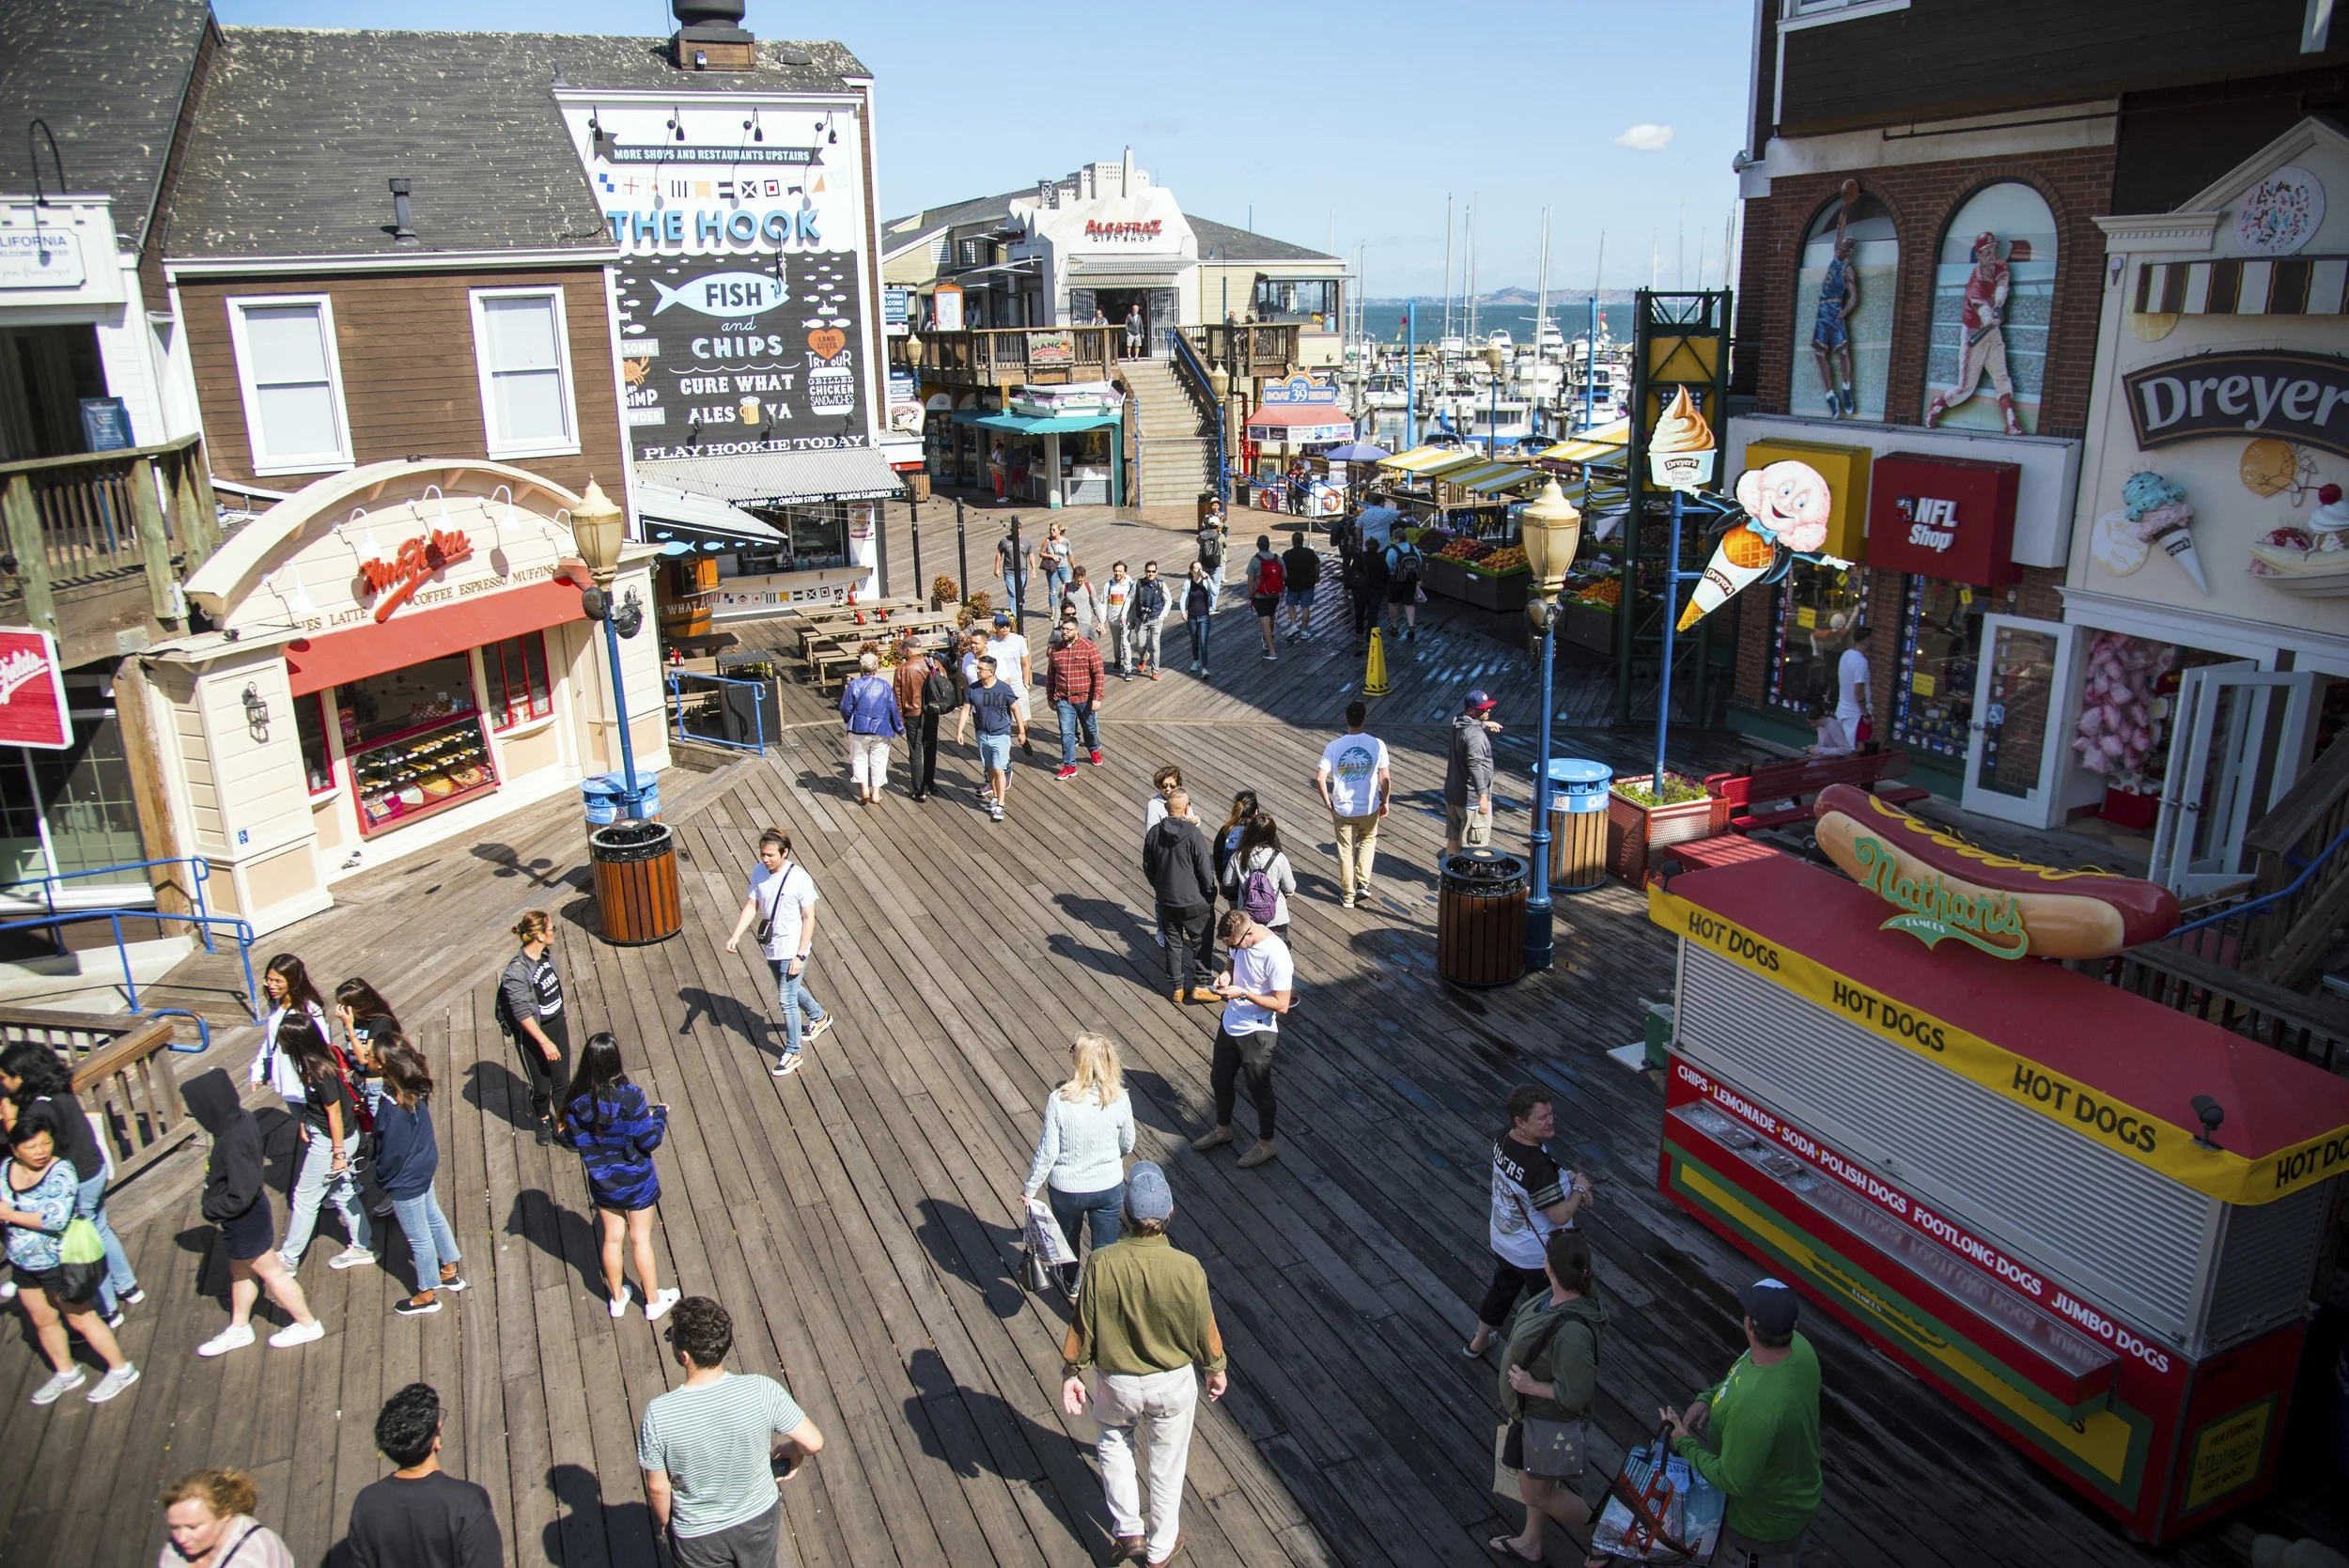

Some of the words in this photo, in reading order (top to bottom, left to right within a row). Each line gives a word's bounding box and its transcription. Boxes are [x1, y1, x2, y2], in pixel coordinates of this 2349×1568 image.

[614, 149, 642, 160] MORE
[644, 149, 675, 161] SHOPS
[677, 149, 696, 160] AND
[698, 149, 764, 161] RESTAURANTS
[766, 149, 810, 162] UPSTAIRS
[606, 210, 685, 241] THE
[697, 210, 822, 241] HOOK
[1085, 219, 1162, 234] ALCATRAZ
[706, 283, 762, 307] FISH
[722, 316, 756, 331] and
[623, 342, 654, 354] SOME
[692, 335, 783, 359] CHIPS
[805, 351, 825, 368] TRY
[680, 377, 729, 395] CURE
[735, 375, 794, 393] WHAT
[809, 384, 854, 396] CHICKEN
[1266, 391, 1290, 401] BOAT
[1291, 389, 1308, 402] 39
[810, 395, 855, 406] SANDWICHES
[688, 406, 736, 425] ALES
[765, 403, 793, 421] YA
[644, 445, 704, 460] PLAY
[707, 439, 790, 457] HOOKIE
[794, 435, 865, 450] TODAY
[1665, 458, 1699, 470] Dreyer's
[778, 496, 804, 505] CHICKEN
[804, 495, 825, 504] STRIPS
[835, 491, 861, 502] SALMON
[1914, 497, 1958, 527] NFL
[1908, 523, 1954, 552] Shop
[1705, 567, 1734, 595] Dreyer's
[329, 607, 368, 626] LATTE
[412, 586, 453, 606] COFFEE
[459, 575, 507, 596] ESPRESSO
[512, 564, 556, 582] MUFFINS
[666, 600, 697, 616] WHAT
[1855, 836, 2025, 936] Nathan's
[1688, 910, 1726, 945] HOT
[1728, 928, 1781, 972] DOGS
[1832, 980, 1877, 1020] HOT
[1882, 1003, 1945, 1053] DOGS
[2012, 1063, 2071, 1111] HOT
[2073, 1092, 2156, 1153] DOGS
[2275, 1143, 2323, 1188] HOT
[1677, 1064, 1708, 1093] CHIPS
[1713, 1084, 1776, 1134] LEMONADE
[1781, 1127, 1815, 1159] SODA
[1820, 1149, 1869, 1191] POLISH
[1868, 1179, 1906, 1214] DOGS
[1913, 1206, 1995, 1267] FOOTLONG
[1996, 1255, 2042, 1296] DOGS
[2051, 1292, 2113, 1339] JUMBO
[2116, 1328, 2170, 1373] DOGS
[2209, 1417, 2257, 1449] FEATURING
[2201, 1475, 2219, 1494] HOT
